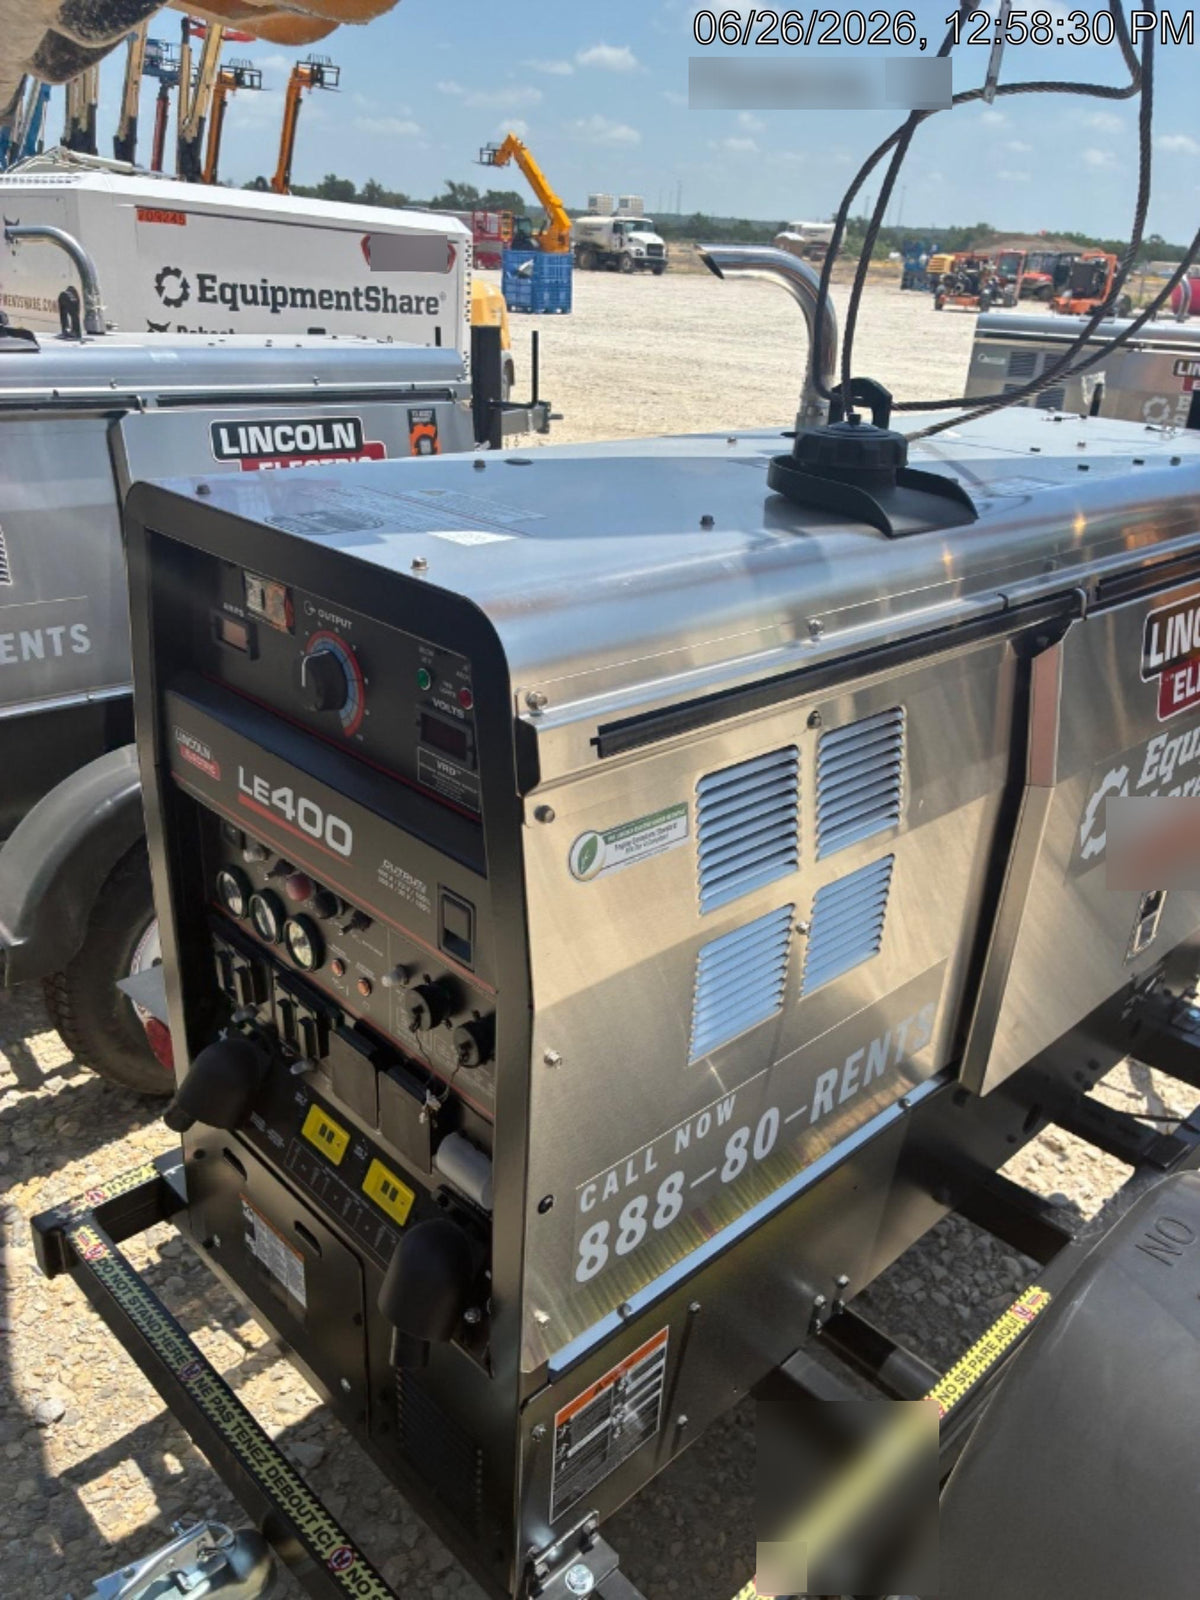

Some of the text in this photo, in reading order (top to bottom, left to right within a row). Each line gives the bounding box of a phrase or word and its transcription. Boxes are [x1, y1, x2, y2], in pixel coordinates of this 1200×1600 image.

[219, 422, 357, 455] LINCOLN
[317, 609, 353, 630] OUTPUT
[432, 697, 465, 719] VOLTS
[238, 766, 353, 856] LE400
[579, 1094, 736, 1213] CALL NOW
[1134, 1216, 1196, 1267] NO
[99, 1258, 189, 1365] DO NOT STAND HERE
[937, 1384, 958, 1403] NO
[953, 1368, 972, 1385] SE
[967, 1341, 998, 1369] PARE
[194, 1378, 336, 1550] NE PAS TENEZ DEBOUT ICI
[346, 1567, 372, 1595] NO
